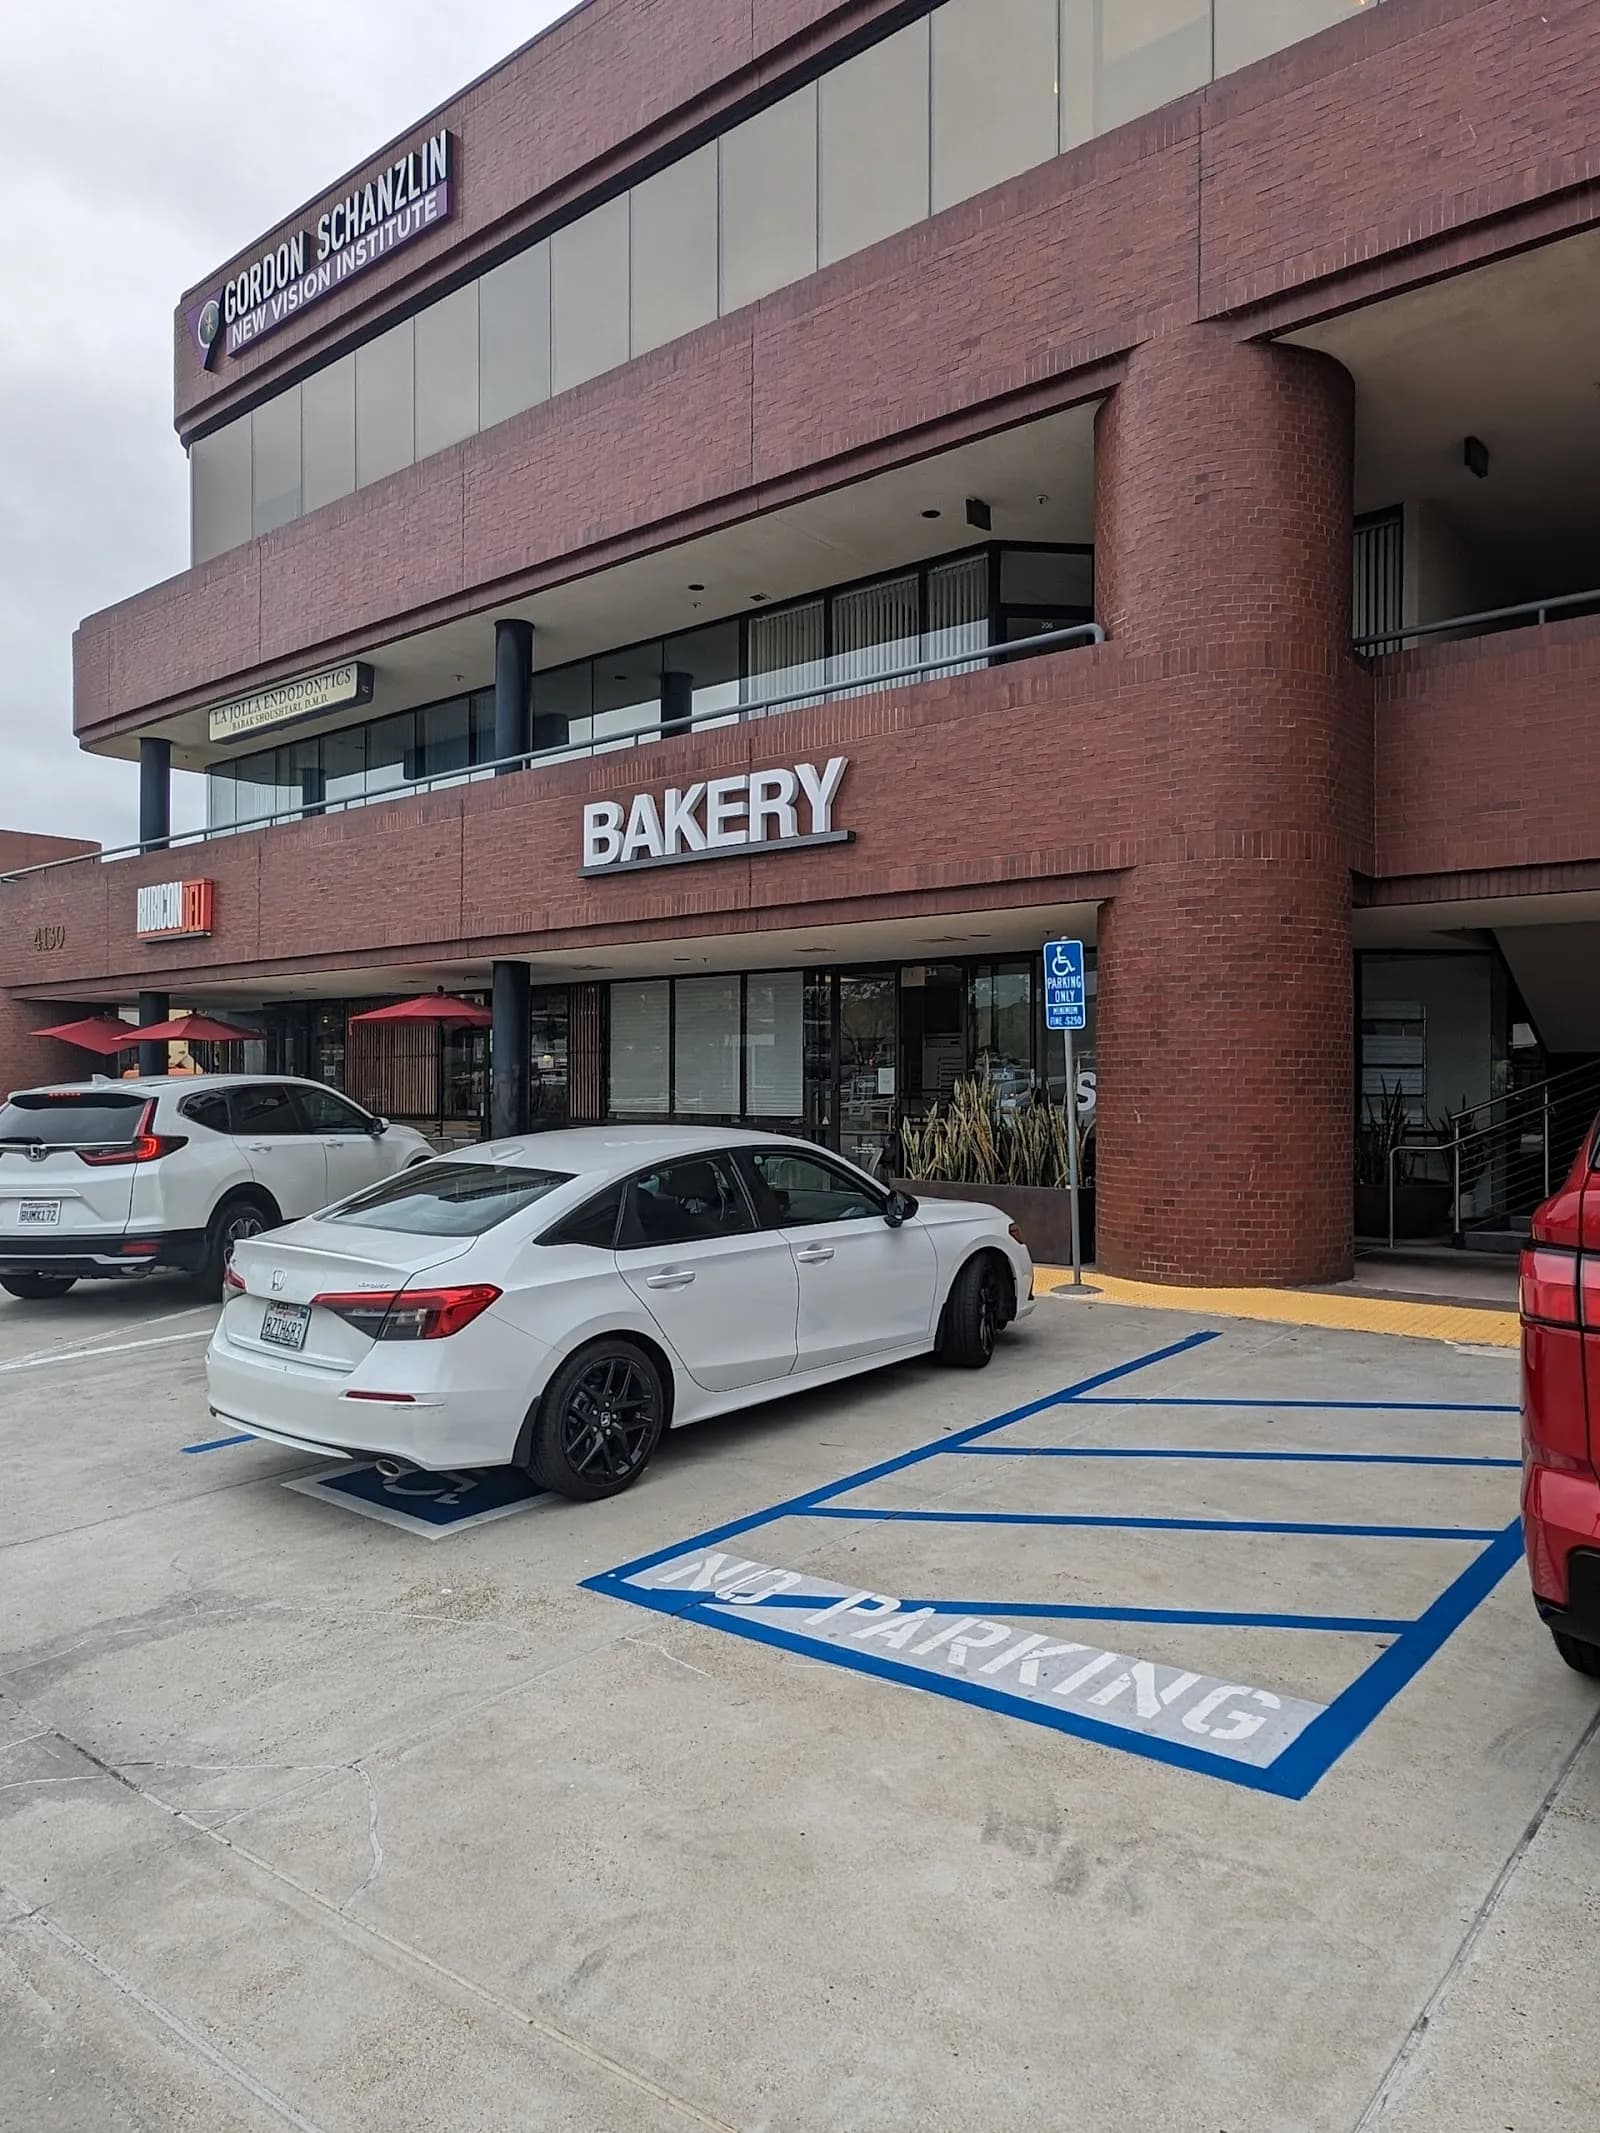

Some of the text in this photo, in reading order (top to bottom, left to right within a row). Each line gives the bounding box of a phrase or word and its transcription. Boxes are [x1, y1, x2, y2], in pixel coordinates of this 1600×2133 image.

[224, 128, 448, 324] GORDON SCHANZLIN
[232, 190, 438, 348] NEW VISION INSTITUTE
[214, 668, 351, 726] LA JOLLA ENDODONTICS
[583, 756, 849, 868] BAKERY
[137, 881, 183, 933] RUBICON
[1047, 976, 1082, 990] PARKING
[1054, 989, 1076, 1002] ONLY
[656, 1552, 1281, 1740] NO PARKING
